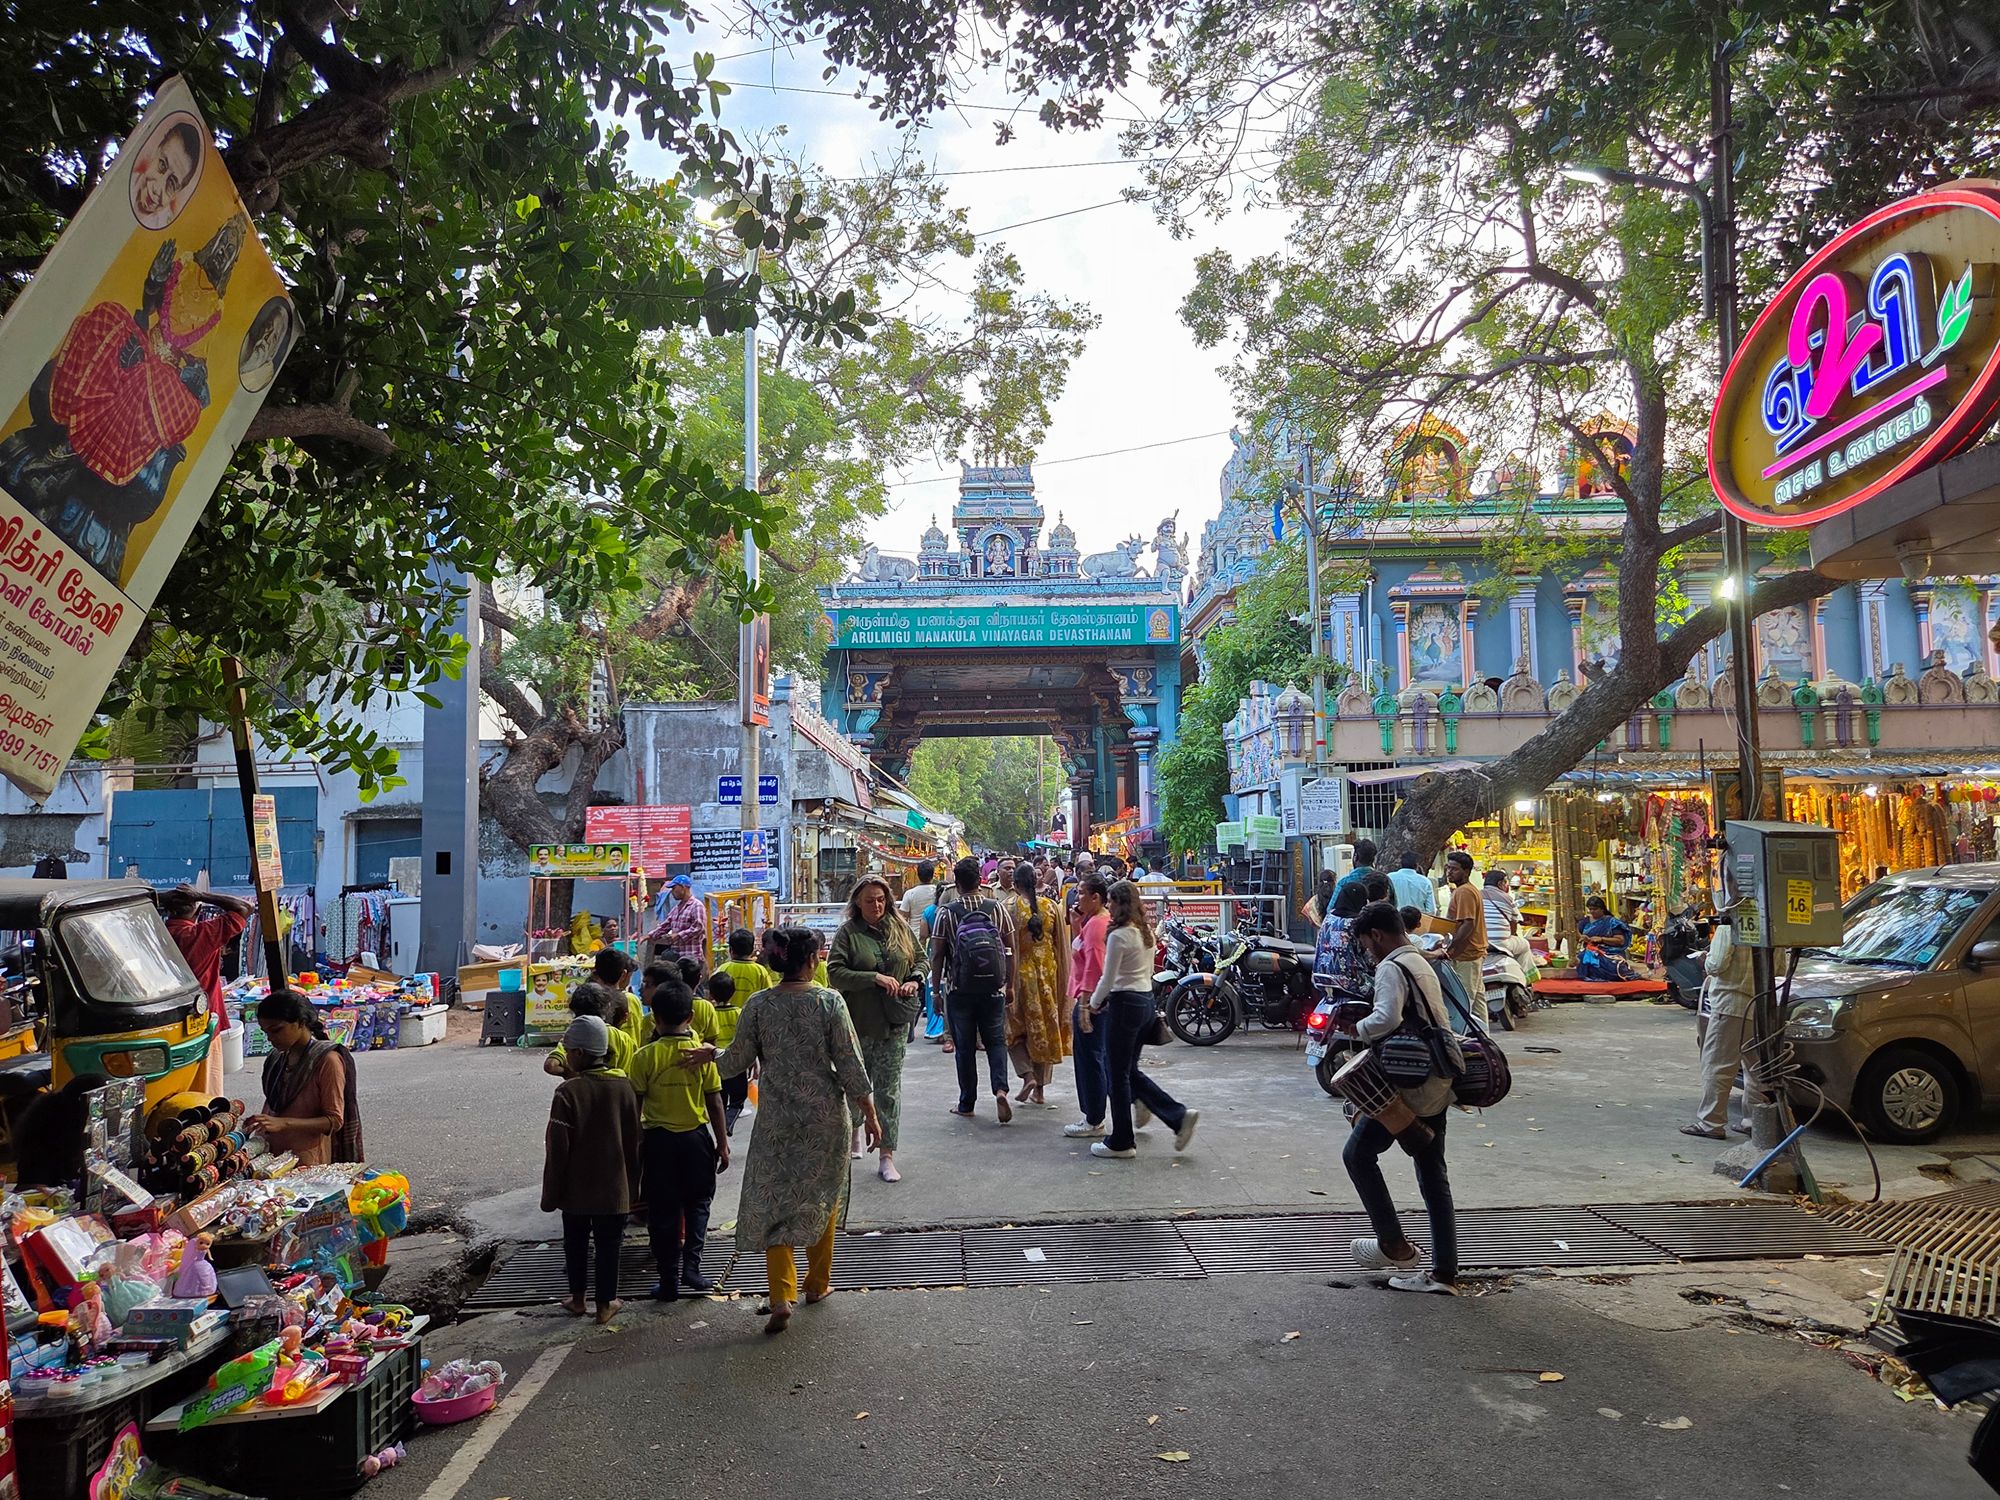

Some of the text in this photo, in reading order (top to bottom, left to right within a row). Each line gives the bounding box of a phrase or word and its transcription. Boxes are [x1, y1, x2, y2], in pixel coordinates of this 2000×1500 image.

[1775, 394, 1932, 505] சைவ உணவகம்
[58, 568, 124, 638] தேவி
[847, 608, 1138, 630] அருள்மிகு மணக்குள விநாயகர் தேவஸ்தானம்
[5, 620, 52, 657] கண்டிகை
[28, 596, 95, 656] கோயில்
[851, 628, 1131, 644] ARULMIGU MANAKULA VINAYAGAR DEVASTHANAM
[7, 645, 55, 680] நிலையம்
[0, 693, 54, 738] அடிகள்
[23, 743, 62, 777] 71571
